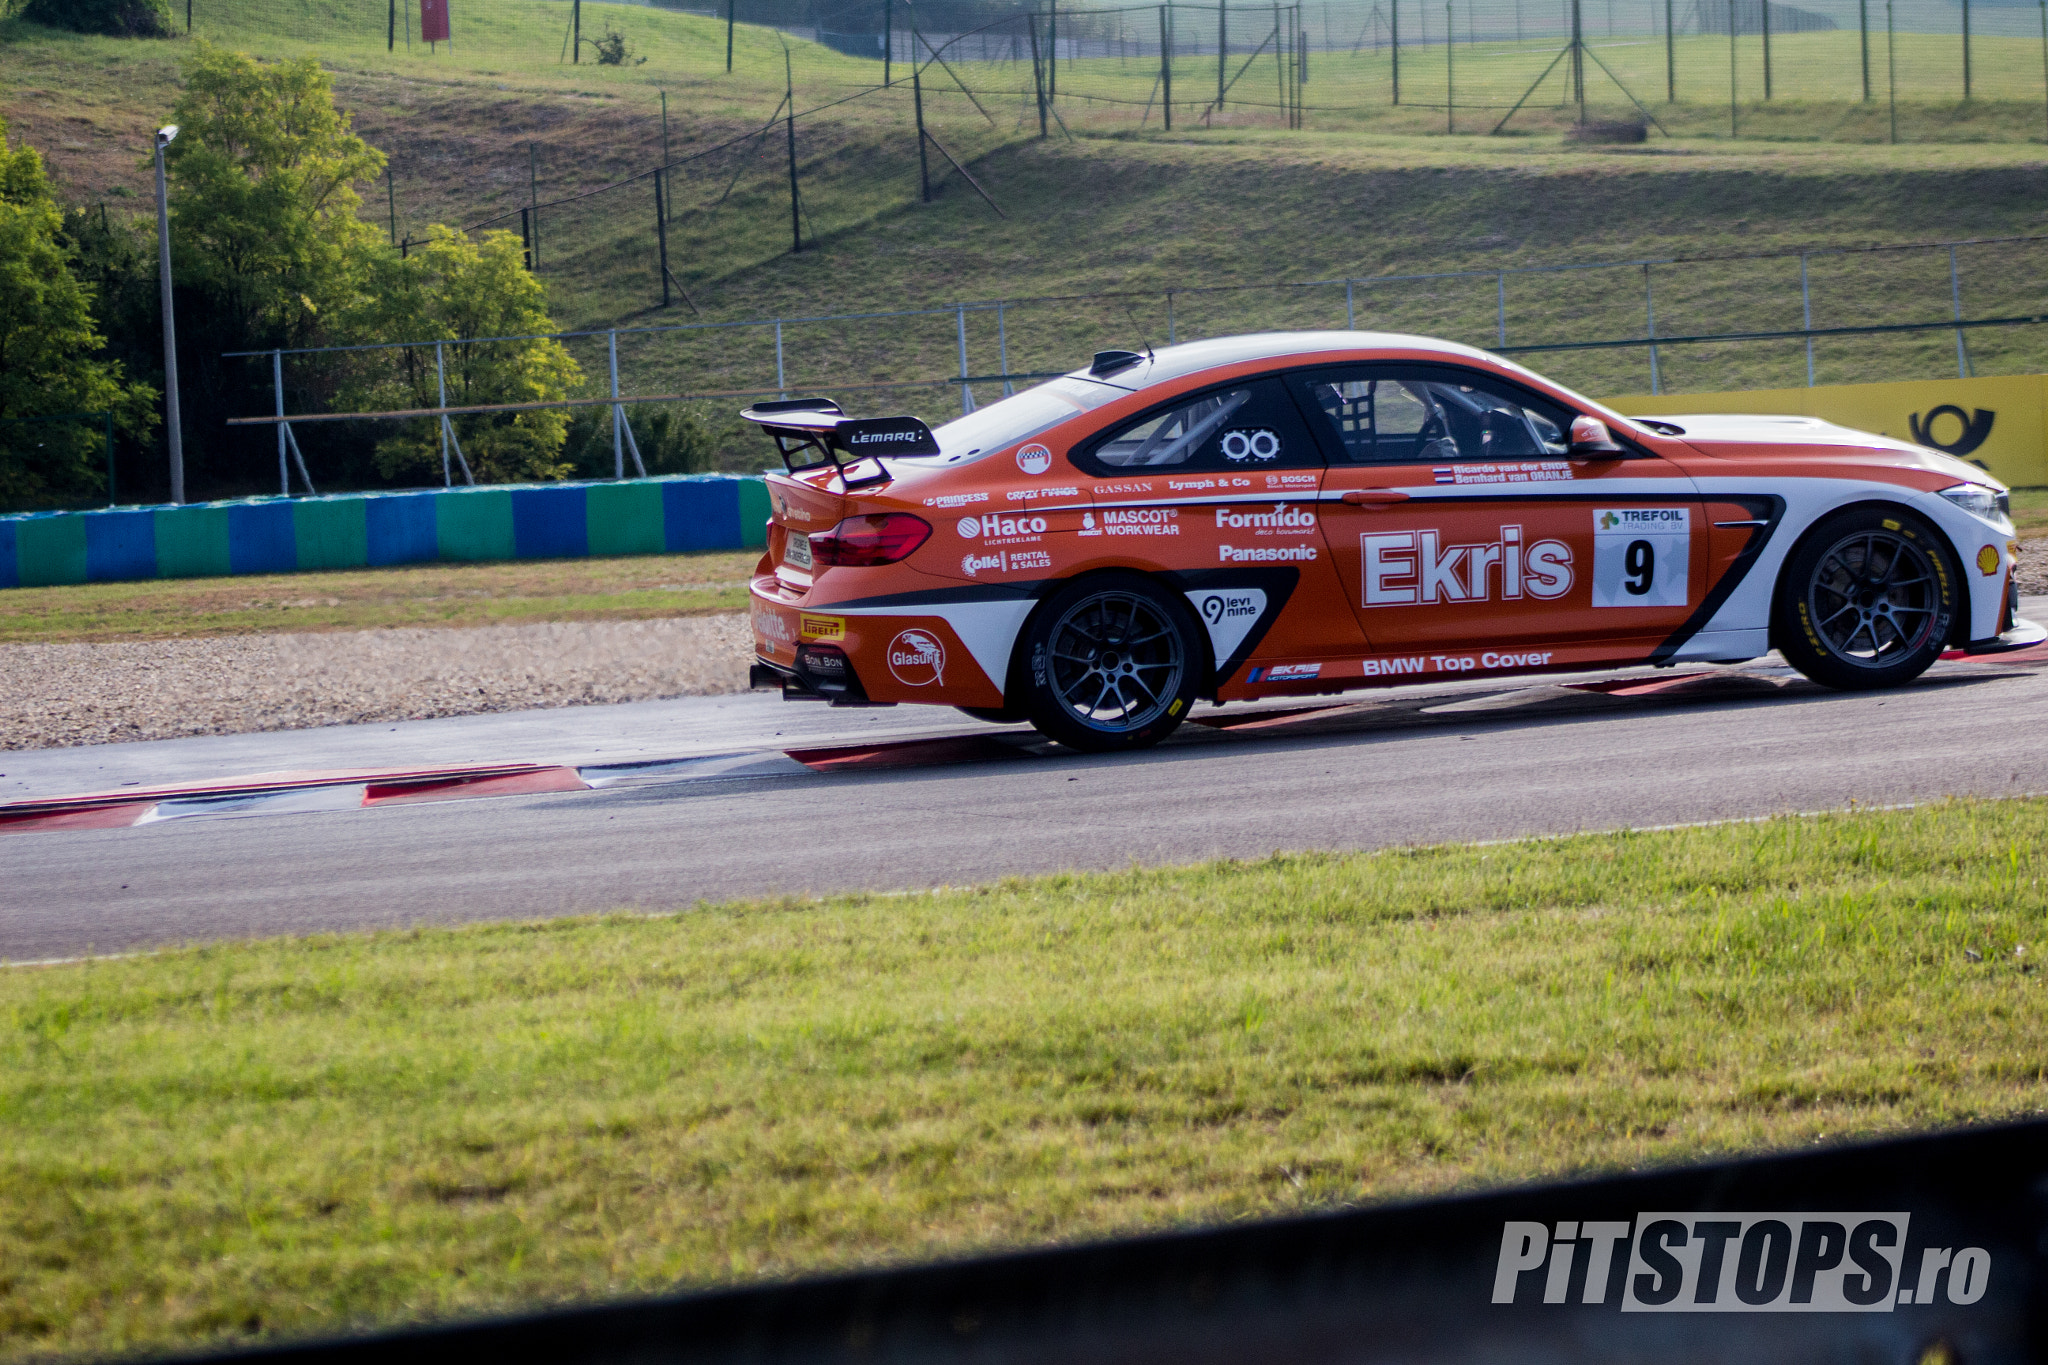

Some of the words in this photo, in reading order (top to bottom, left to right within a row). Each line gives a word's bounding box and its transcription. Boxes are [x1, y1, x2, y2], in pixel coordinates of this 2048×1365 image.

[851, 432, 917, 444] LEMARQ
[1453, 463, 1495, 474] Ricardo
[1497, 464, 1519, 473] van
[1520, 462, 1538, 472] der
[1540, 462, 1570, 471] ENDE
[1281, 475, 1316, 484] BOSCH
[1455, 472, 1506, 484] Bernhard
[1508, 473, 1528, 482] van
[1529, 470, 1573, 481] ORANJE
[1094, 482, 1152, 495] GASSAN
[1168, 478, 1215, 491] Lymph
[1218, 478, 1230, 487] &
[1232, 477, 1250, 487] Co
[936, 492, 989, 505] PRINCESS
[1006, 489, 1040, 501] CRAZY
[1215, 503, 1315, 527] Formido
[1622, 510, 1684, 522] TREFOIL
[981, 515, 1047, 538] Haco
[1105, 524, 1179, 536] WORKWEAR
[1622, 521, 1666, 531] TRADING
[1670, 521, 1684, 530] BV
[984, 535, 1042, 546] LICHTREKLAME
[1010, 551, 1050, 561] RENTAL
[1219, 544, 1317, 561] Panasonic
[961, 554, 1001, 576] Collé
[1011, 562, 1019, 570] &
[1020, 559, 1051, 569] SALES
[1360, 524, 1574, 608] Ekris
[1624, 539, 1656, 596] 9
[1926, 550, 1950, 606] PIRELLI
[1226, 597, 1250, 608] levi
[1227, 605, 1256, 617] nine
[803, 618, 840, 637] PIRELLI
[804, 654, 821, 666] BON
[823, 656, 843, 667] BON
[892, 651, 941, 666] Glasurit
[1363, 656, 1425, 676] BMW
[1430, 654, 1477, 673] Top
[1481, 651, 1553, 669] Cover
